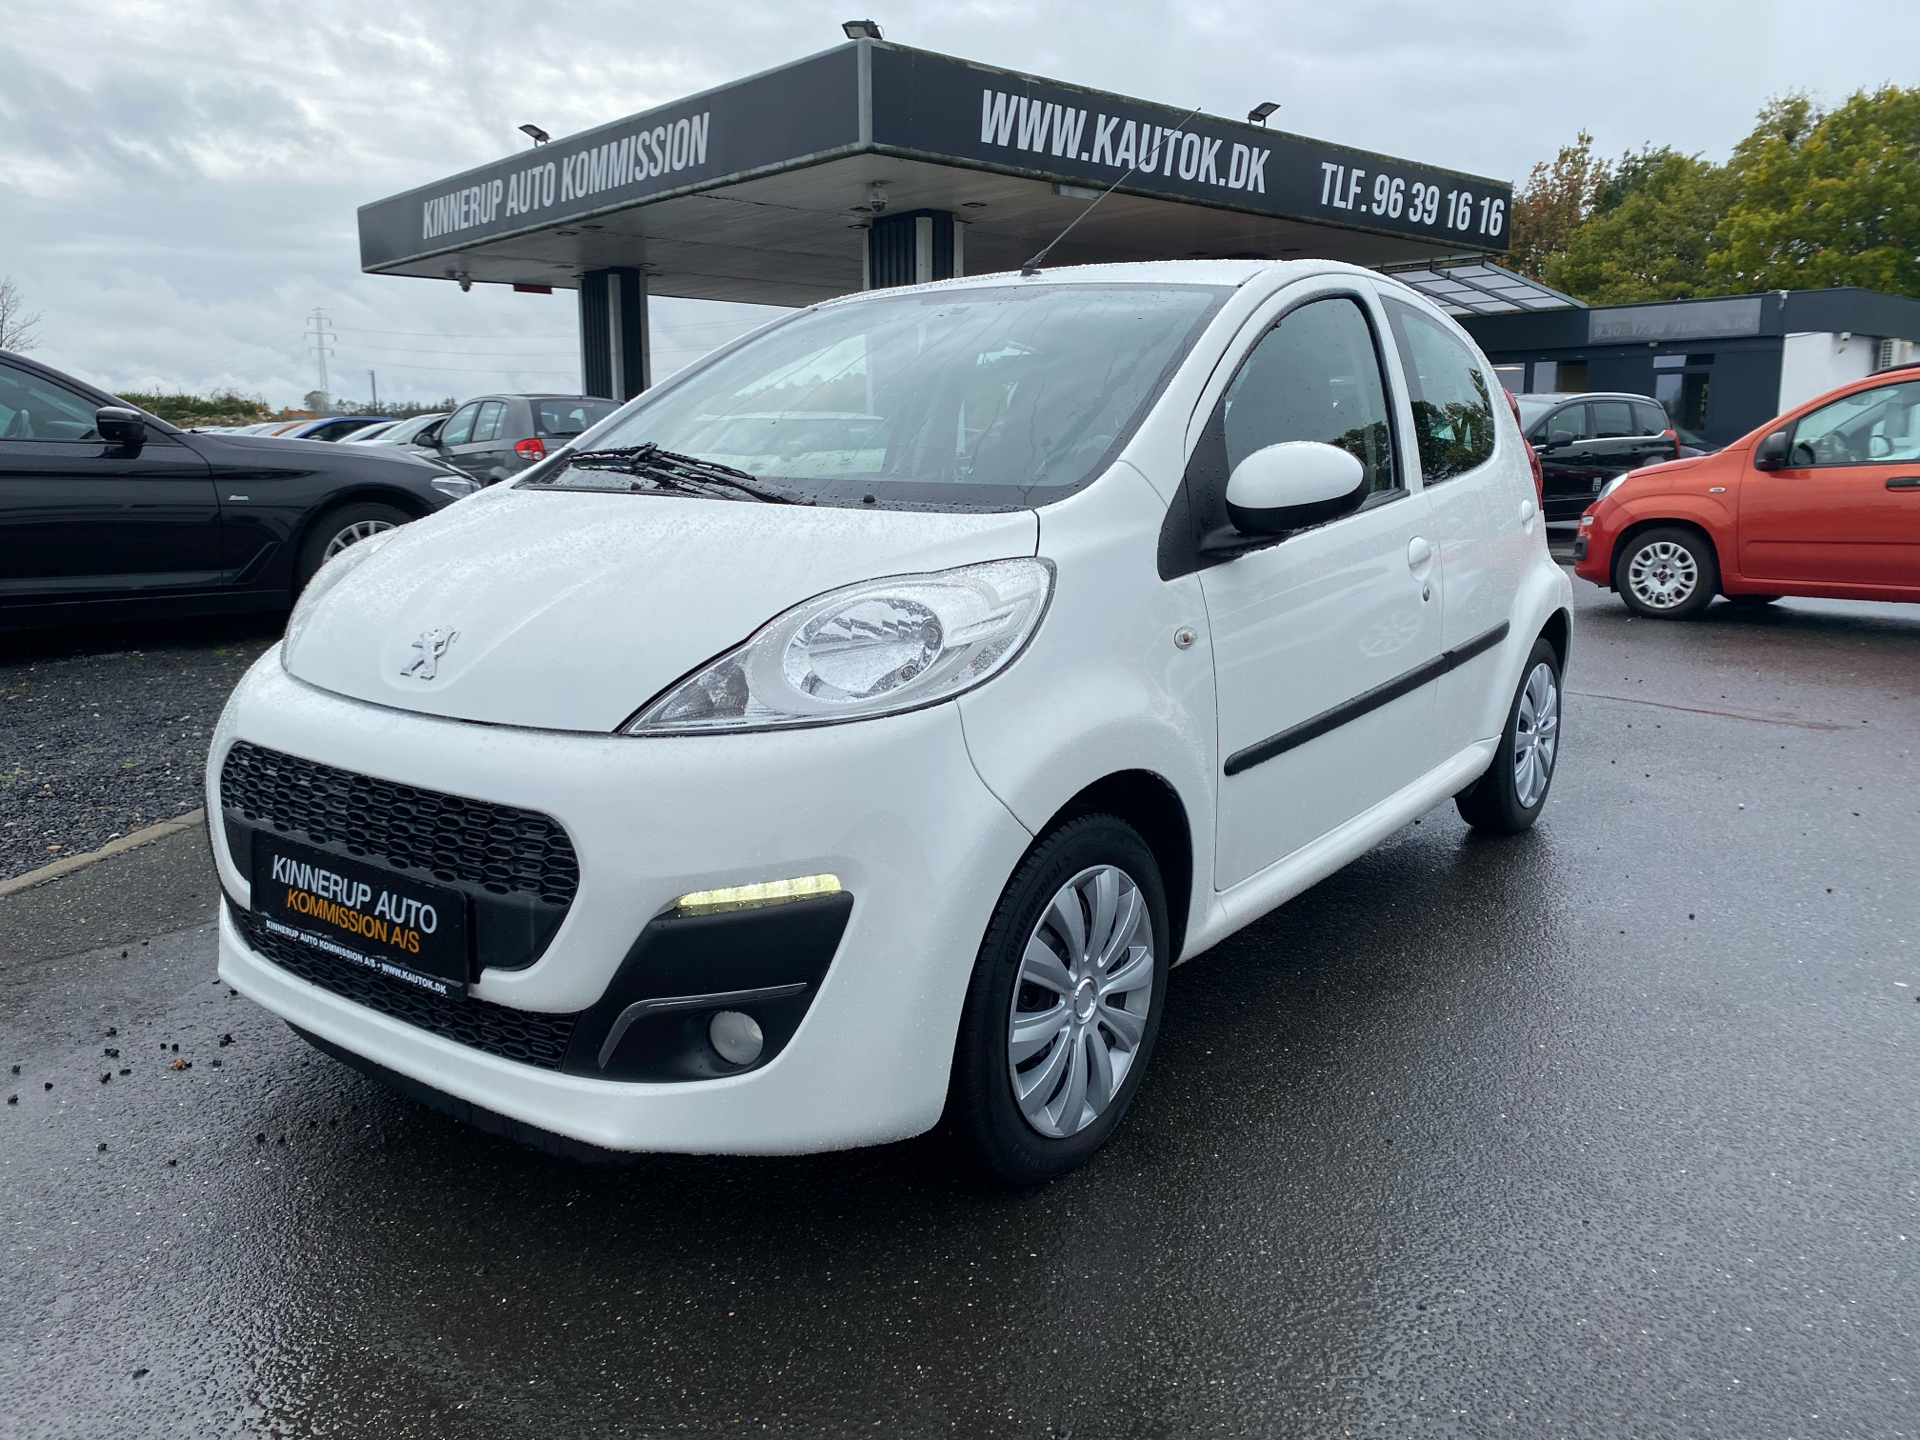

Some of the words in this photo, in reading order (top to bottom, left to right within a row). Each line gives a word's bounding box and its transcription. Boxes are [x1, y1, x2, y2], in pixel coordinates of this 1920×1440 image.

[422, 179, 503, 240] KINNERUP
[506, 162, 556, 217] AUTO
[561, 112, 710, 202] KOMMISSION
[980, 89, 1271, 194] WWW.KAUTOK.DK
[1321, 162, 1367, 212] TLF.
[1372, 174, 1406, 219] 96
[1408, 182, 1440, 225] 39
[1447, 190, 1472, 231] 16
[1479, 196, 1505, 237] 16
[272, 854, 371, 909] KINNERUP
[374, 890, 438, 933] AUTO
[286, 888, 387, 942] KOMMISSION
[390, 926, 420, 953] A/S
[266, 919, 299, 938] KINNERUP
[299, 933, 318, 946] AUTO
[319, 940, 363, 963] KOMMISSION
[381, 963, 447, 995] WWW.KAUTOK.DK
